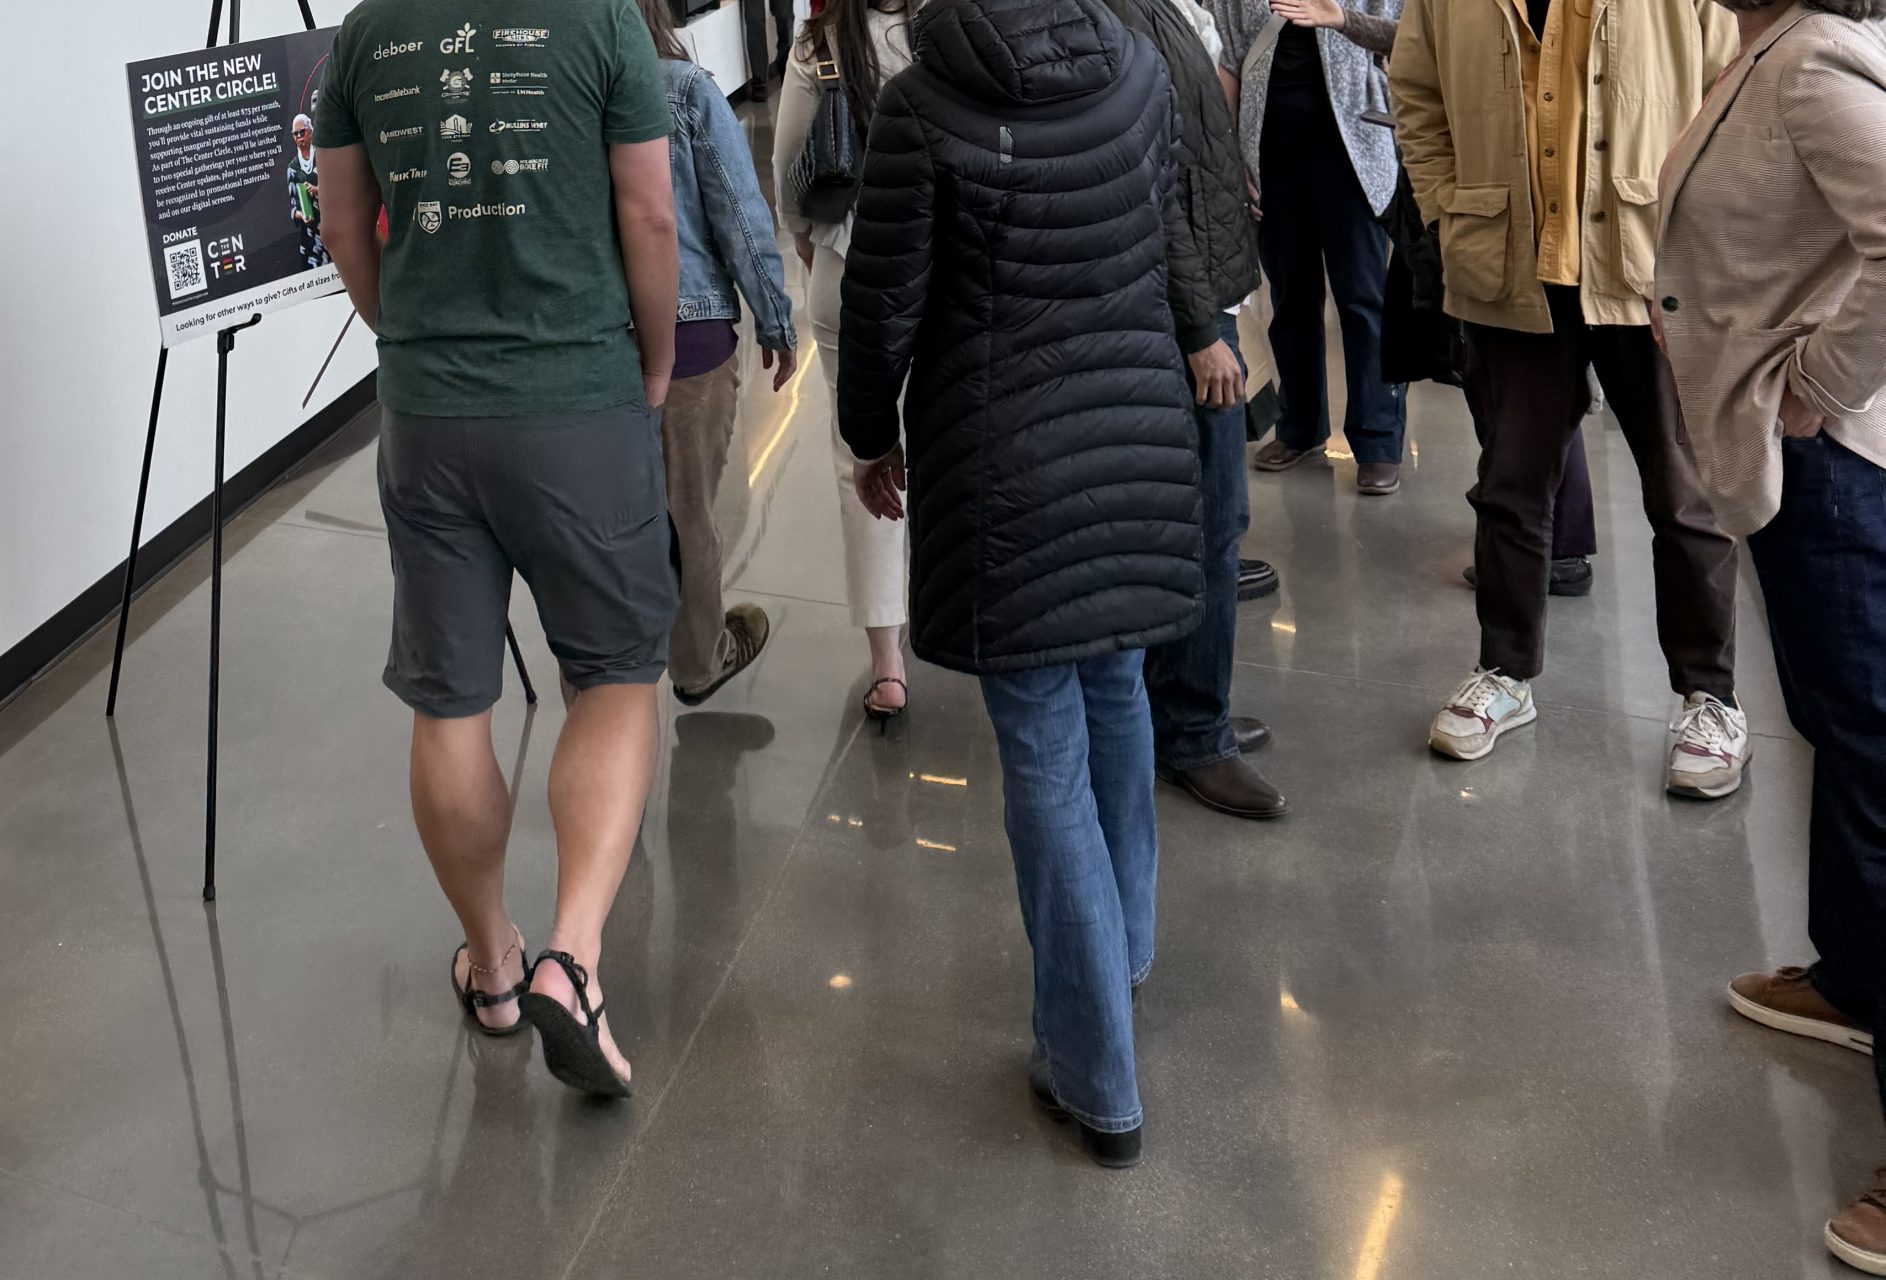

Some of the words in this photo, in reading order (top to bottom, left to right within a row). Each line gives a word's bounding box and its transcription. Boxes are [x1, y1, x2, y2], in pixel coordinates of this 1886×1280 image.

[439, 33, 475, 55] GFL
[495, 29, 548, 38] FIREHOUSE
[373, 40, 424, 61] deboer
[141, 68, 183, 93] JOIN
[185, 61, 220, 84] THE
[223, 53, 262, 77] NEW
[144, 85, 212, 115] CENTER
[215, 72, 278, 100] CIRCLE!
[146, 122, 173, 136] Through
[181, 117, 205, 129] ongoing
[205, 114, 214, 125] gift
[214, 112, 221, 121] of
[221, 112, 227, 120] at
[227, 109, 240, 119] least
[251, 106, 261, 115] per
[261, 100, 281, 111] month,
[166, 131, 190, 145] provide
[191, 127, 204, 138] vital
[204, 122, 235, 136] sustaining
[235, 116, 252, 128] funds
[252, 114, 268, 124] while
[386, 126, 423, 138] MIDWEST
[150, 146, 183, 161] supporting
[183, 138, 212, 152] inaugural
[212, 133, 240, 148] programs
[240, 128, 251, 138] and
[251, 123, 283, 138] operations.
[152, 163, 160, 172] As
[161, 161, 173, 172] part
[174, 156, 181, 166] of
[181, 155, 193, 166] The
[193, 152, 213, 163] Center
[249, 139, 256, 148] be
[257, 135, 277, 146] invited
[153, 175, 160, 184] to
[161, 173, 173, 182] two
[173, 166, 194, 179] special
[194, 161, 225, 176] gatherings
[225, 158, 235, 168] per
[235, 155, 248, 166] year
[249, 151, 266, 161] where
[155, 184, 176, 196] receive
[176, 179, 196, 191] Center
[222, 170, 234, 181] plus
[234, 167, 247, 178] your
[248, 163, 264, 173] name
[264, 158, 275, 168] will
[156, 198, 165, 208] be
[165, 190, 198, 206] recognized
[198, 188, 206, 198] in
[206, 178, 243, 195] promotional
[243, 172, 270, 186] materials
[158, 209, 171, 220] and
[171, 208, 180, 217] on
[180, 205, 191, 214] our
[191, 198, 211, 212] digital
[211, 193, 235, 205] screens.
[448, 202, 526, 220] Production
[162, 226, 198, 244] DONATE
[175, 315, 205, 331] Looking
[206, 311, 216, 322] for
[217, 305, 236, 318] other
[236, 301, 255, 313] ways
[255, 297, 263, 305] to
[263, 291, 281, 305] give?
[282, 286, 298, 297] Gifts
[298, 281, 305, 291] of
[306, 279, 315, 289] all
[315, 276, 331, 286] sizes
